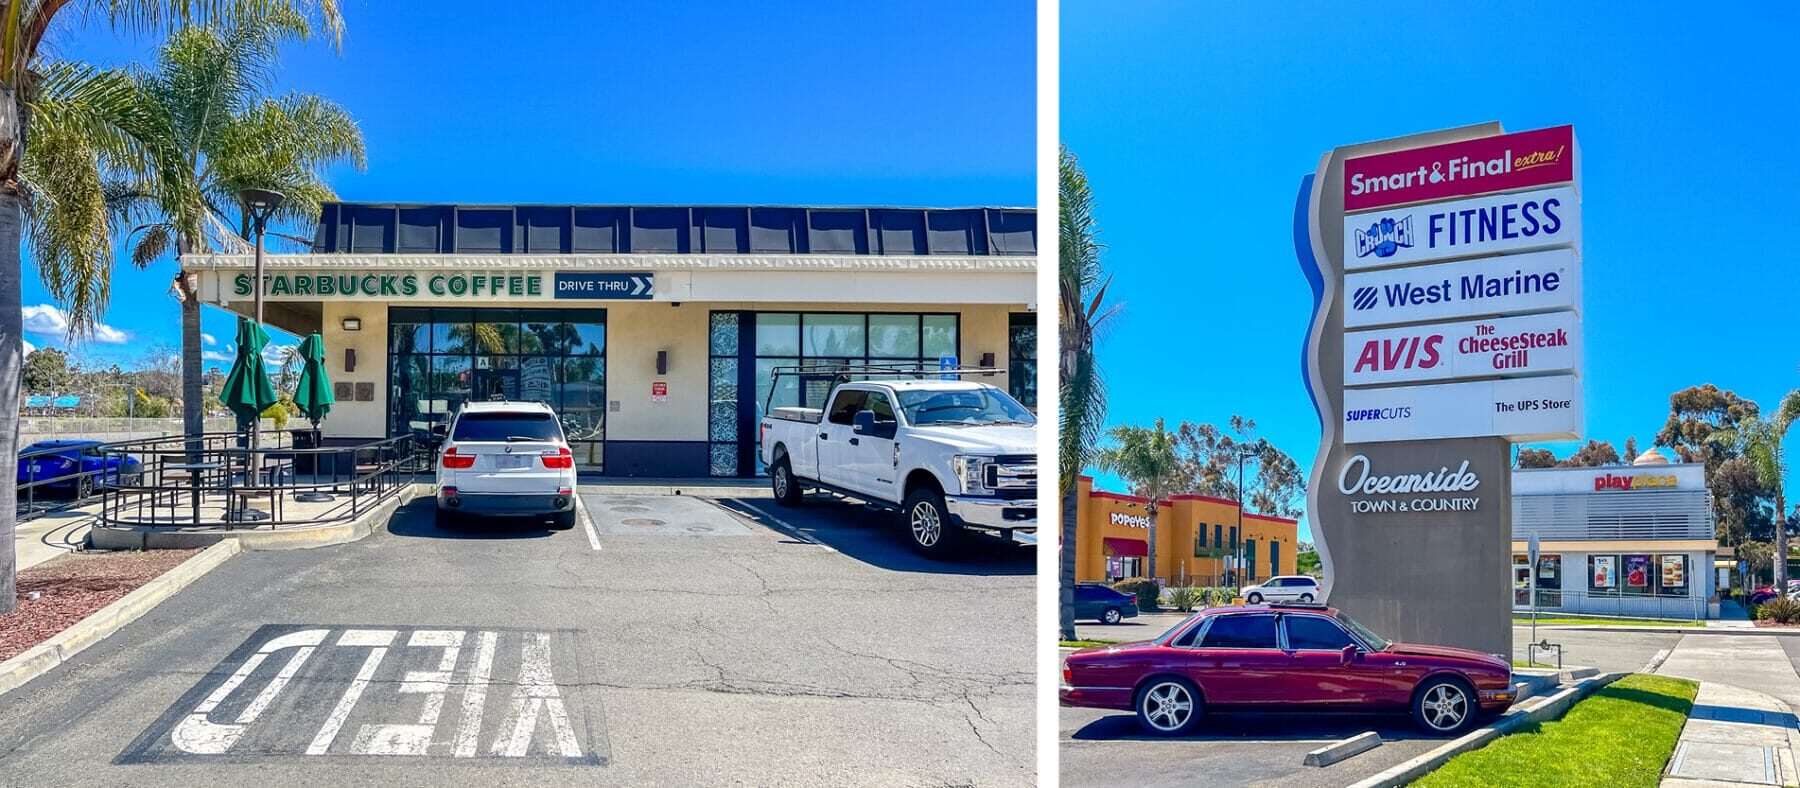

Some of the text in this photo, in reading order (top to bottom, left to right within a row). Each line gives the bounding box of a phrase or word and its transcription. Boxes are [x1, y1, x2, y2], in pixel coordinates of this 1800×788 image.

[1514, 145, 1565, 170] extra!
[1429, 198, 1561, 249] FITNESS
[234, 273, 542, 296] STARBUCKS COFFEE
[559, 280, 629, 291] DRIVE THRU
[1384, 269, 1560, 308] West Marine
[1458, 328, 1568, 355] CheeseSteak
[1475, 325, 1495, 336] The
[1353, 334, 1444, 373] AVIS
[1492, 350, 1528, 370] Grill
[1346, 406, 1411, 421] SUPERCUTS
[1495, 399, 1569, 413] The UPS Store
[1338, 454, 1480, 495] Oceanside
[1594, 472, 1678, 491] playplace
[1351, 497, 1480, 514] TOWN & COUNTRY
[171, 628, 584, 759] YIELD
